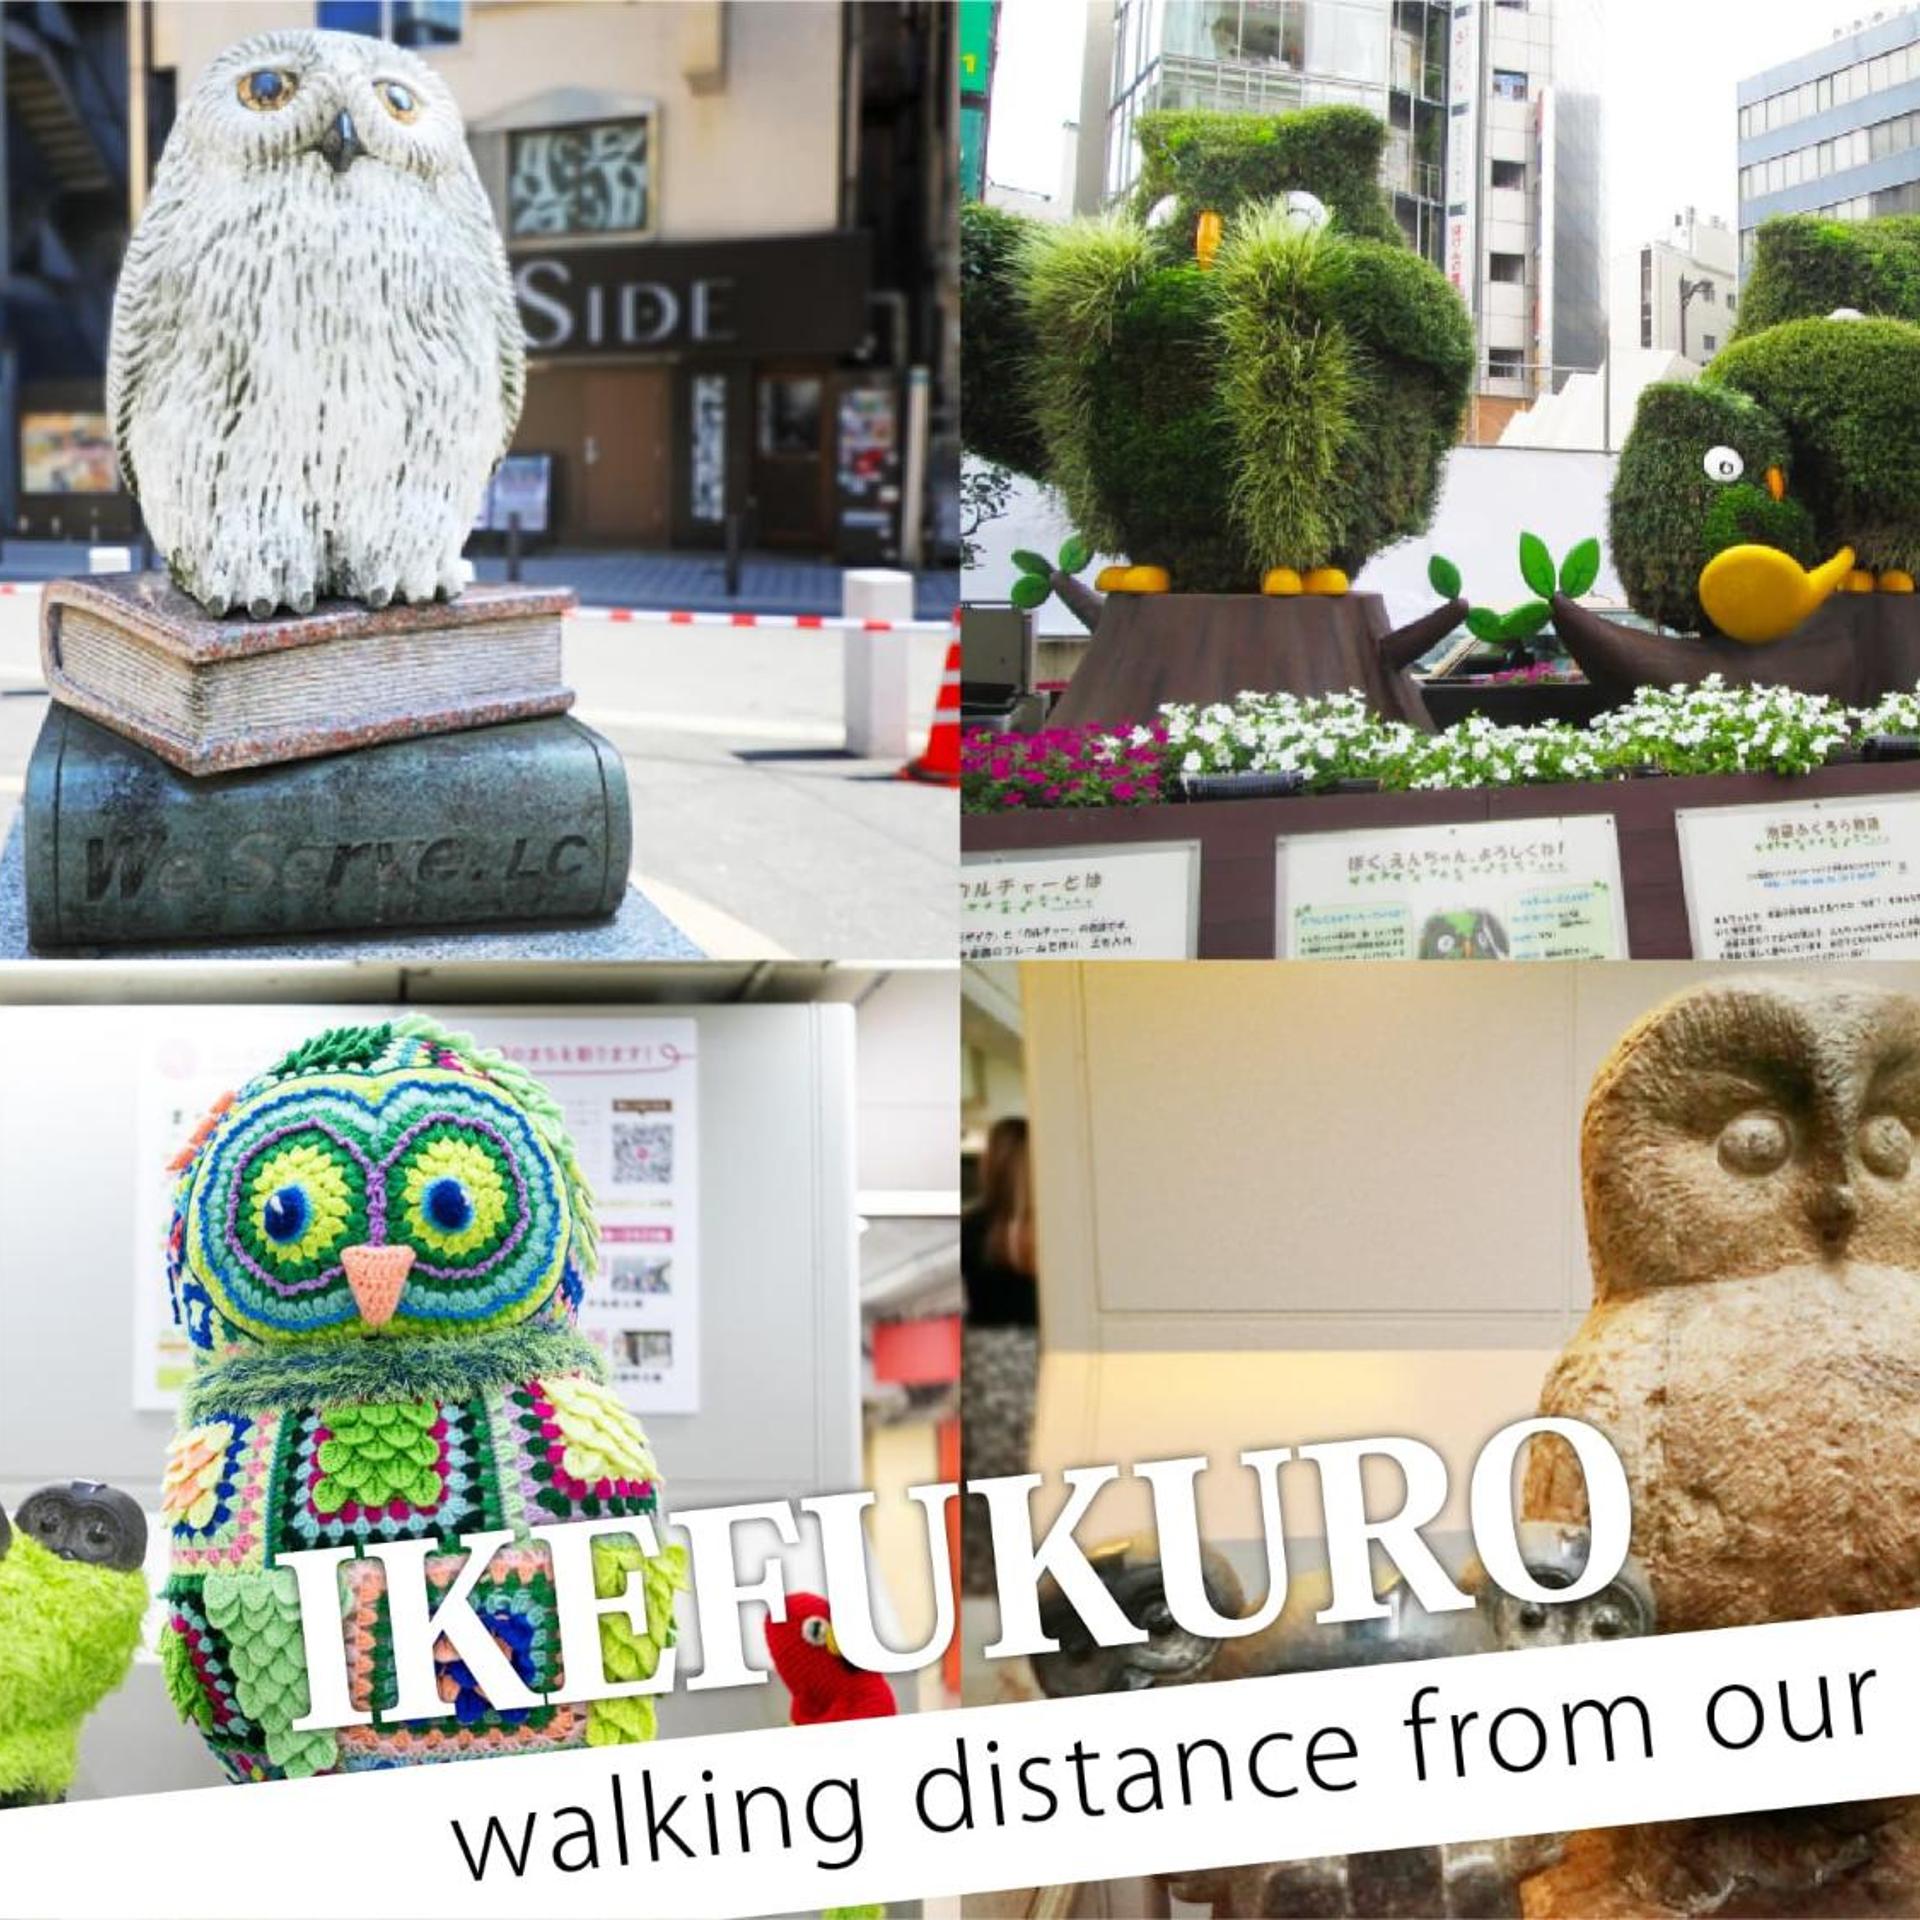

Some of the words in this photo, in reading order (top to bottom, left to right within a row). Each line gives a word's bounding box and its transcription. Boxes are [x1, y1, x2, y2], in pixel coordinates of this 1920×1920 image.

[515, 257, 735, 349] SIDE
[86, 828, 199, 901] We
[506, 834, 590, 881] LC
